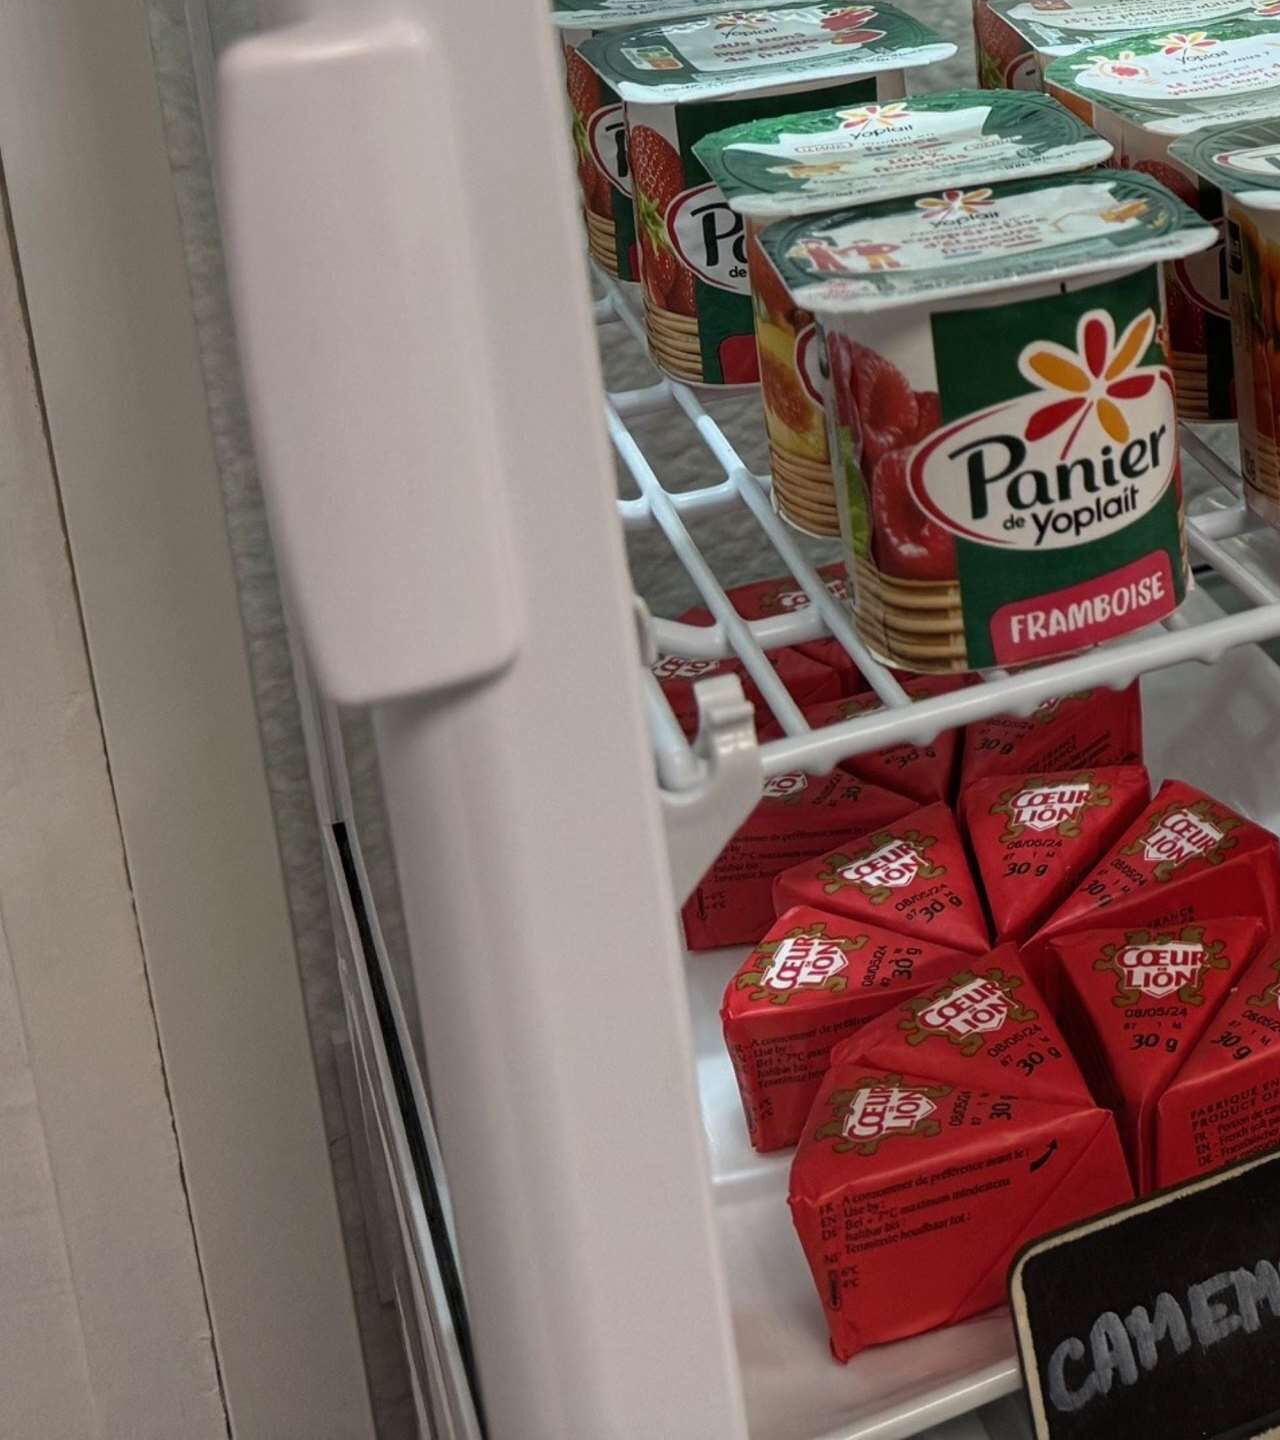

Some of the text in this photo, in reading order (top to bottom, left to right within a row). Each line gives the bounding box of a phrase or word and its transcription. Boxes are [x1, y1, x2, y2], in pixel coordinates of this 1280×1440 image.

[728, 266, 747, 279] de
[947, 423, 1168, 522] Panier
[1001, 484, 1140, 546] de Yoplait
[1009, 572, 1167, 645] FRAMBOISE
[1004, 862, 1031, 877] 30
[920, 900, 945, 924] 30
[1130, 1034, 1179, 1052] 30 g
[1016, 1046, 1062, 1078] 30 g
